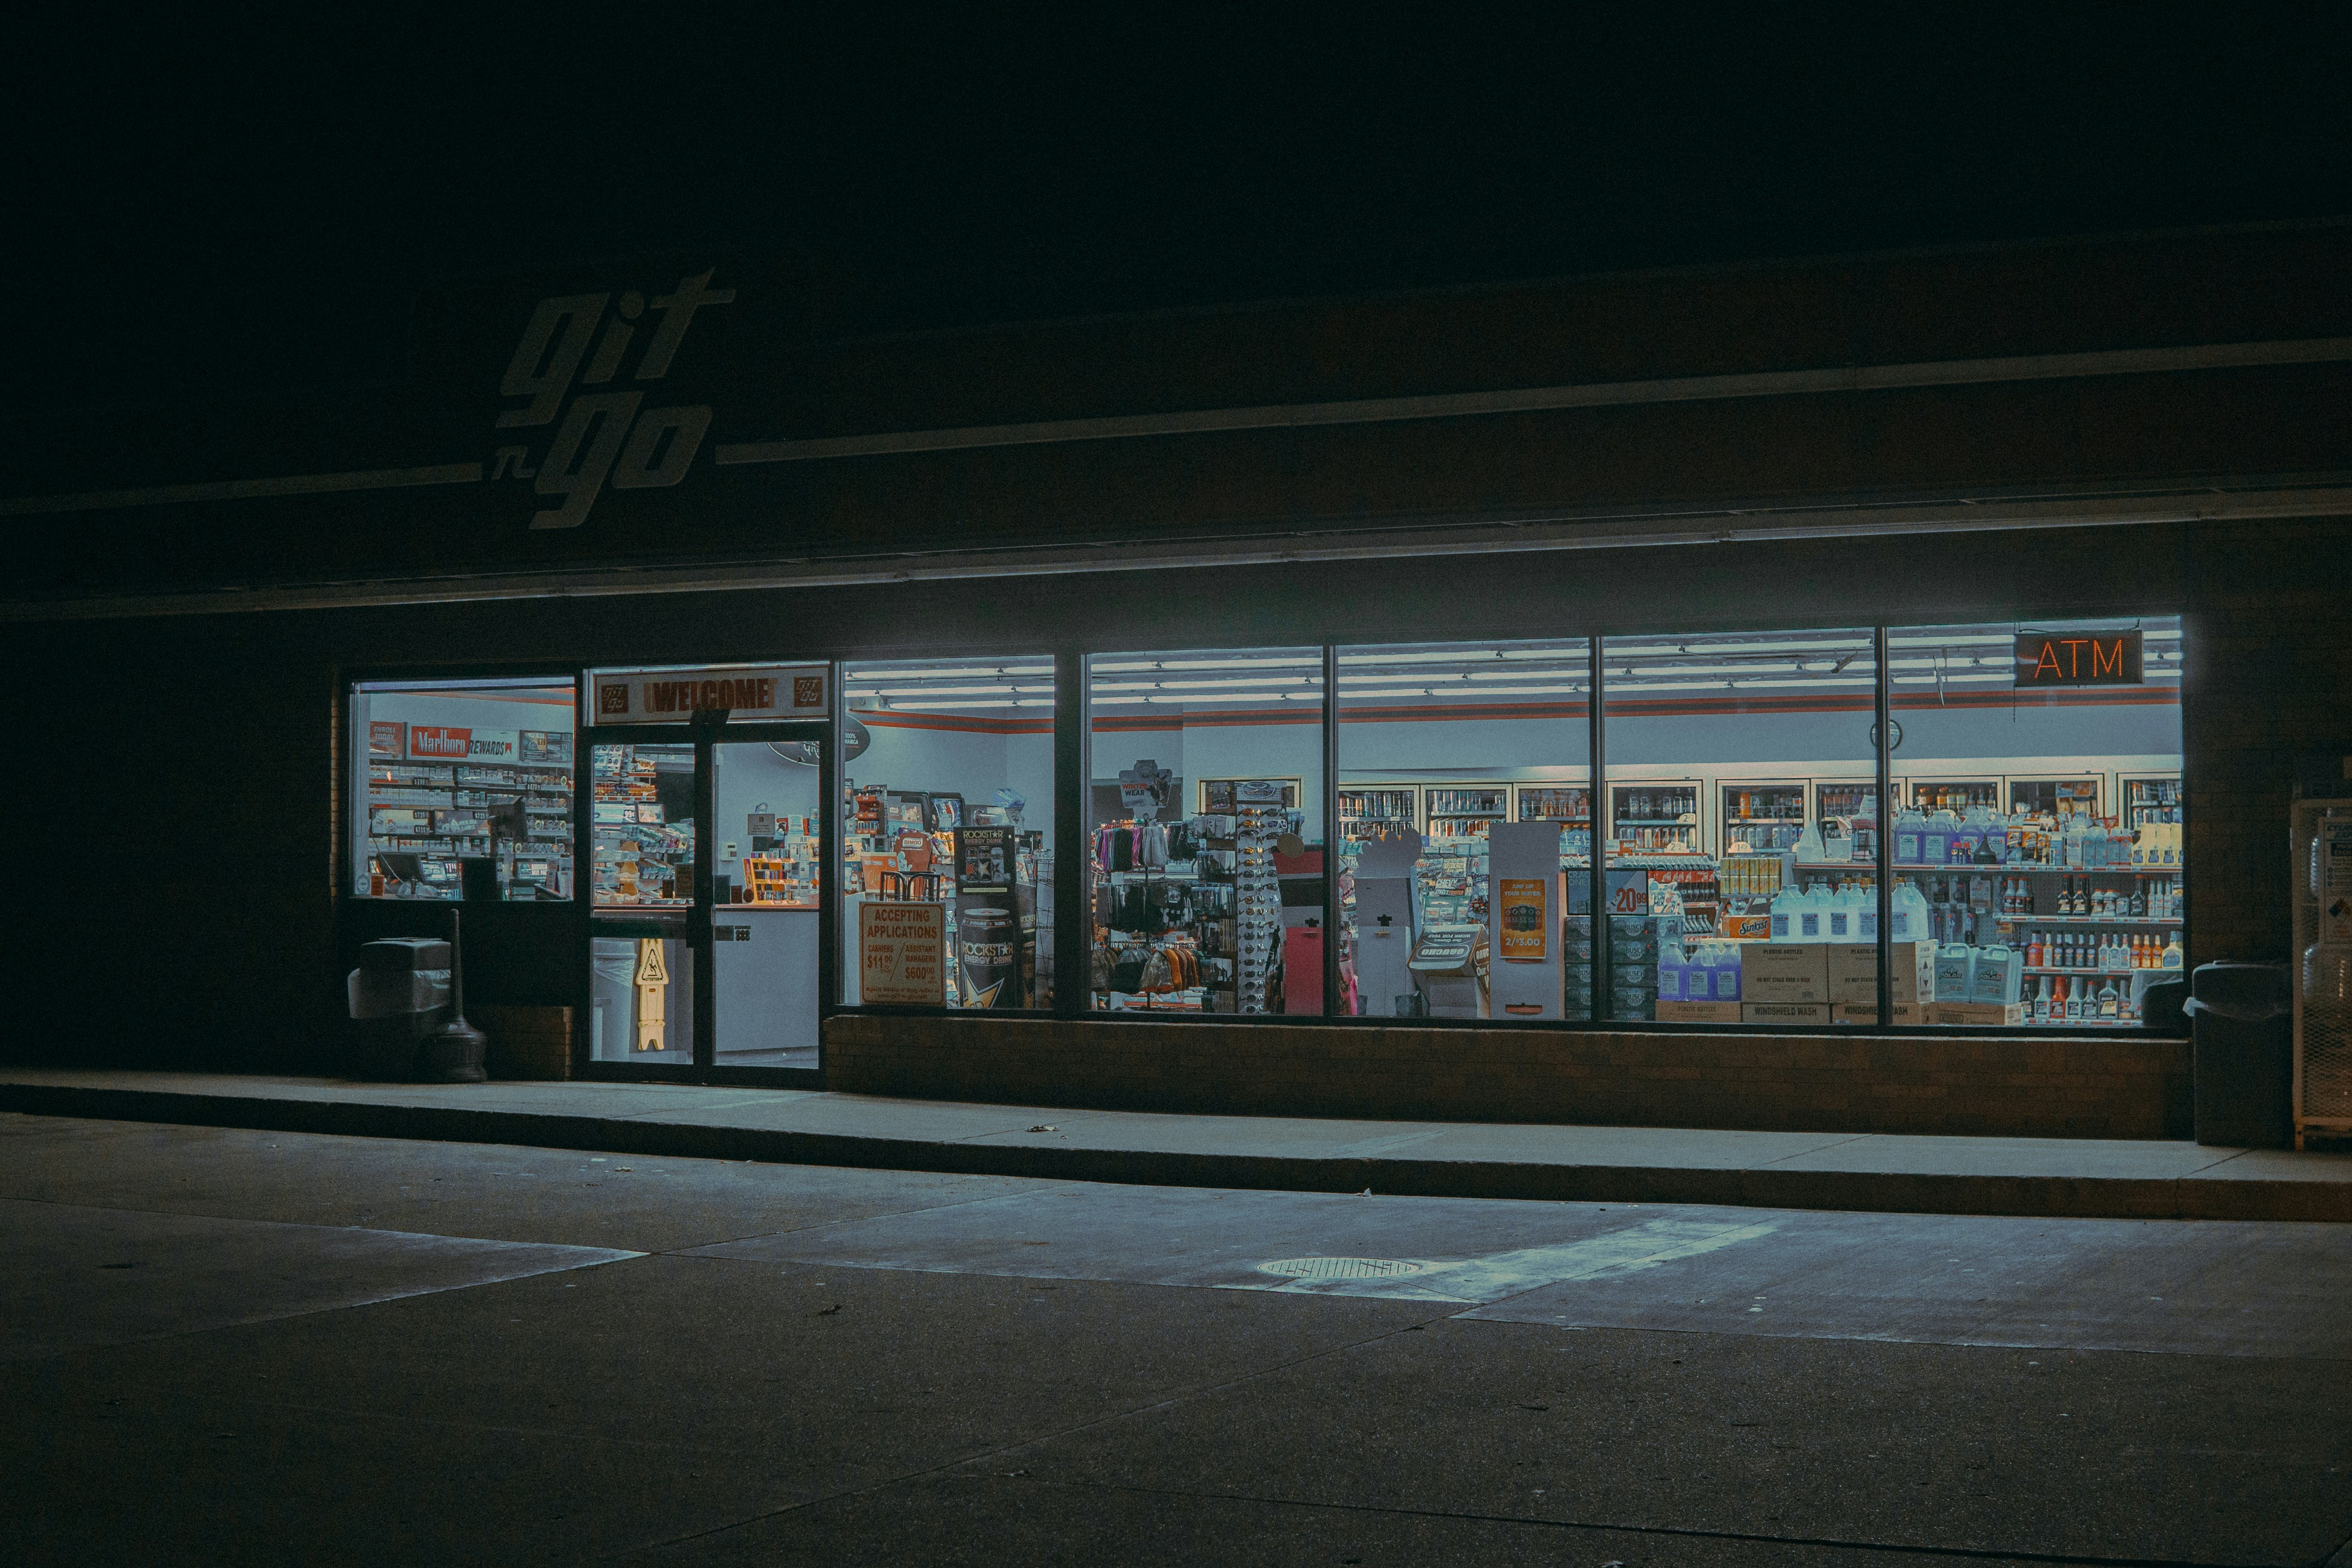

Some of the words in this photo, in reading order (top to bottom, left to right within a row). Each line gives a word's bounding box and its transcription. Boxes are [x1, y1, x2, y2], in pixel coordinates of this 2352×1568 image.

[495, 267, 737, 428] git
[529, 390, 713, 530] go
[2034, 638, 2123, 678] ATM
[652, 678, 771, 712] WELCOME
[418, 730, 466, 754] Marlboro
[467, 739, 505, 755] REWARDS
[874, 909, 930, 922] ACCEPTING
[867, 925, 937, 939] APPLICATIONS
[1739, 920, 1769, 935] Sunkist
[964, 955, 990, 964] ENERGY
[993, 955, 1013, 964] DRINK
[1755, 1006, 1796, 1015] WINDSHIELD
[1798, 1007, 1817, 1016] WASH
[1844, 1006, 1877, 1015] WINDSHIE
[1893, 1007, 1908, 1015] ASH
